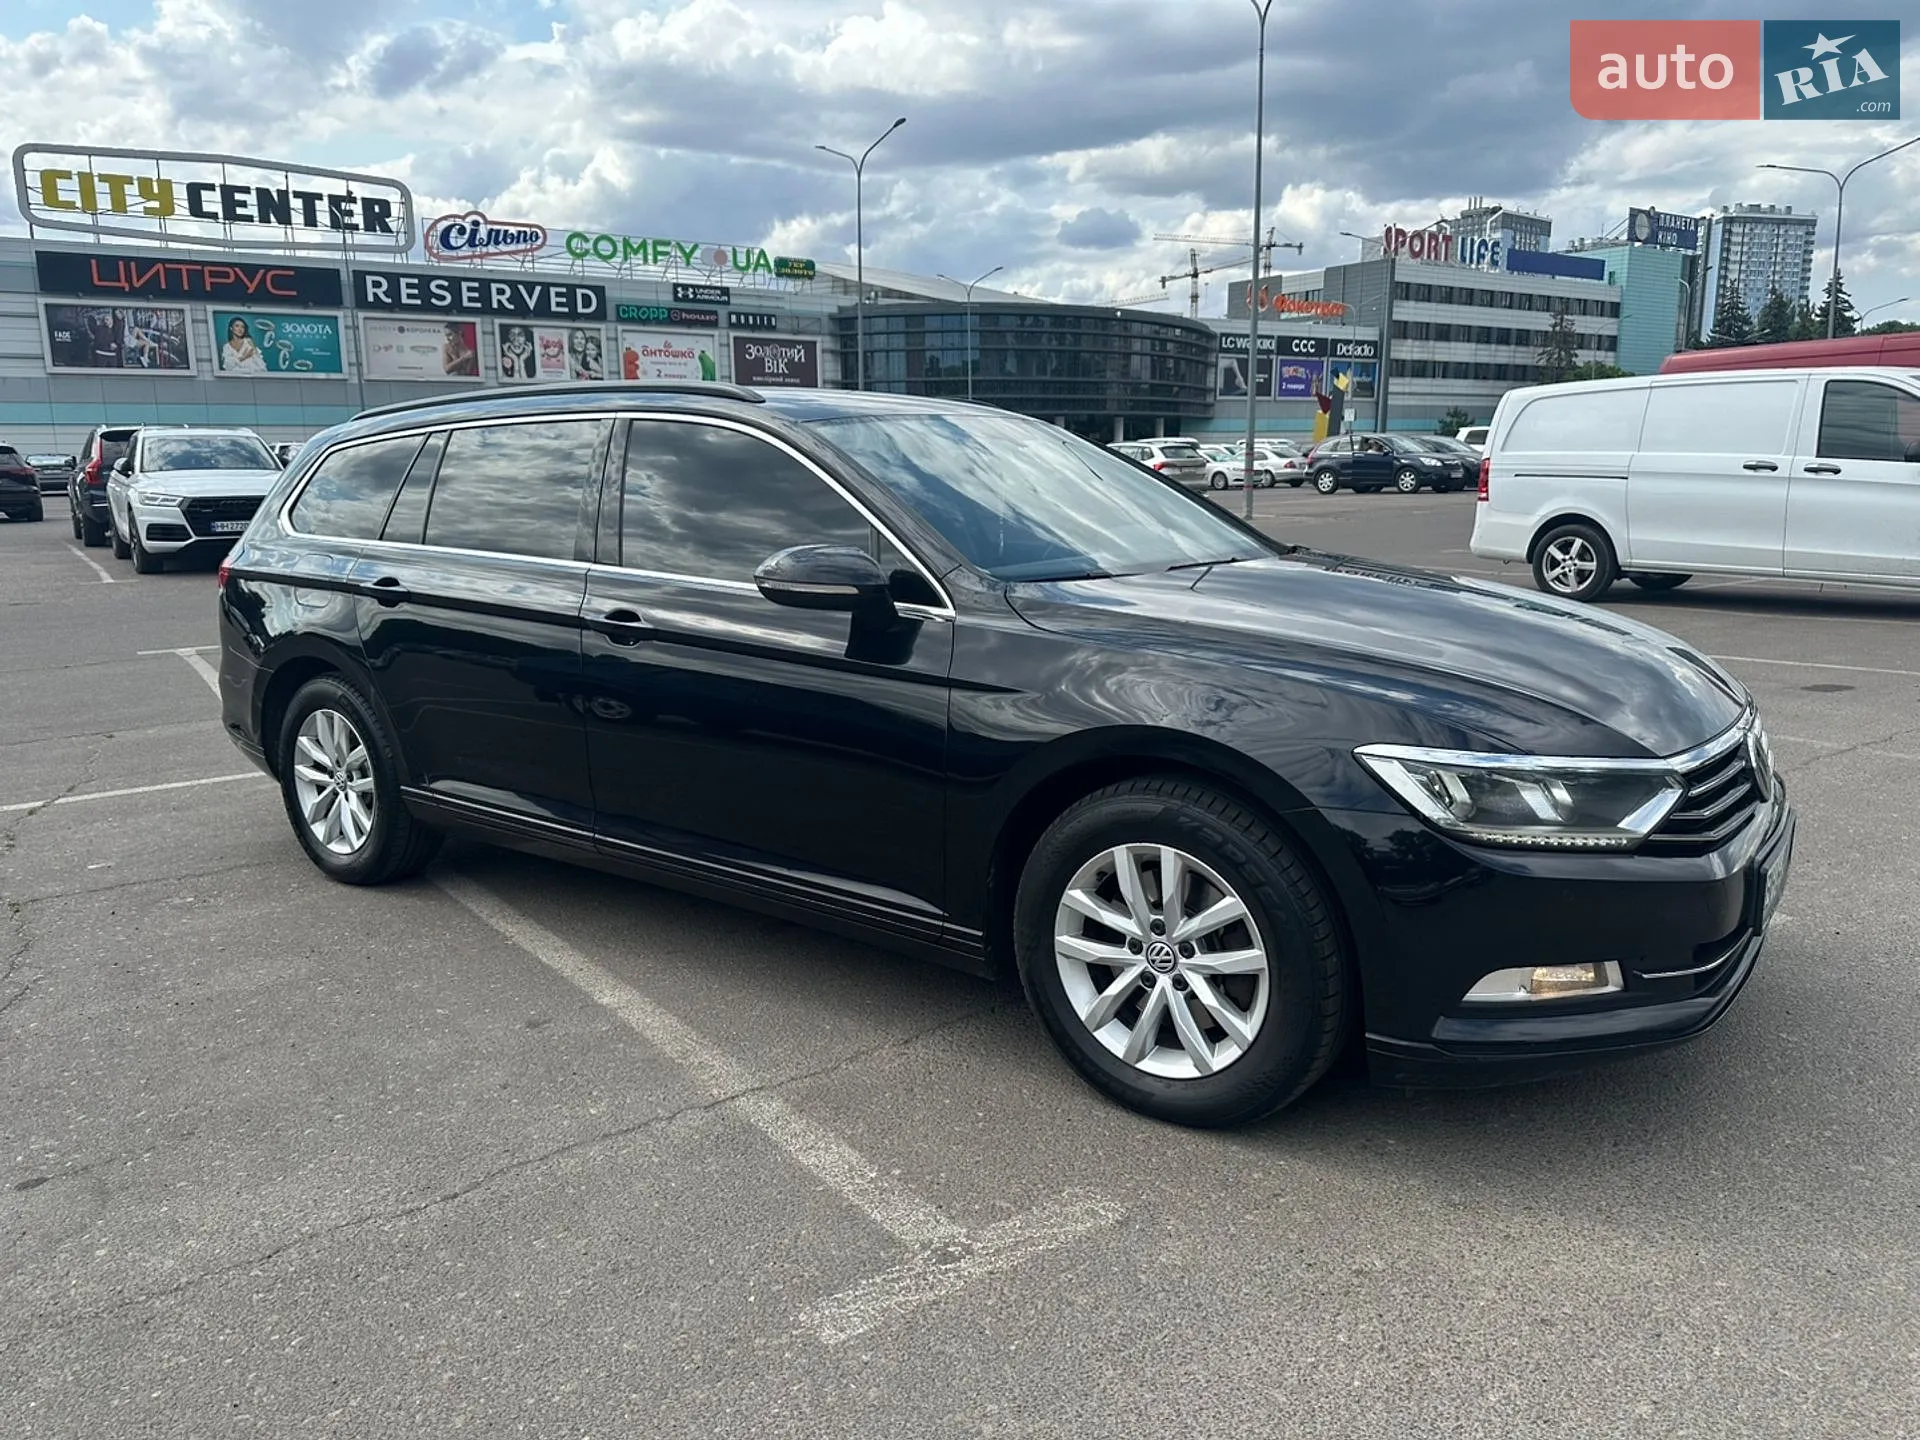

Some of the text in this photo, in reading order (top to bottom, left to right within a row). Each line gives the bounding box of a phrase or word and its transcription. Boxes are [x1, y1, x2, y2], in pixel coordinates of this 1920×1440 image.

[40, 169, 395, 234] CITY CENTER
[1658, 213, 1695, 232] ПЛАНЕТА
[439, 219, 541, 251] Сільпо
[1382, 224, 1453, 260] SPORT
[565, 230, 773, 275] COMFY UA
[90, 258, 298, 297] ЦИТРУС
[365, 274, 599, 316] RESERVED
[694, 287, 721, 295] UNDER
[696, 293, 729, 302] ARMOUR
[619, 305, 669, 320] CROPP
[281, 322, 333, 335] ЗОЛОТА
[1221, 336, 1235, 348] LC
[1291, 339, 1316, 353] CCC
[656, 368, 663, 378] 2
[764, 357, 789, 374] ВІК
